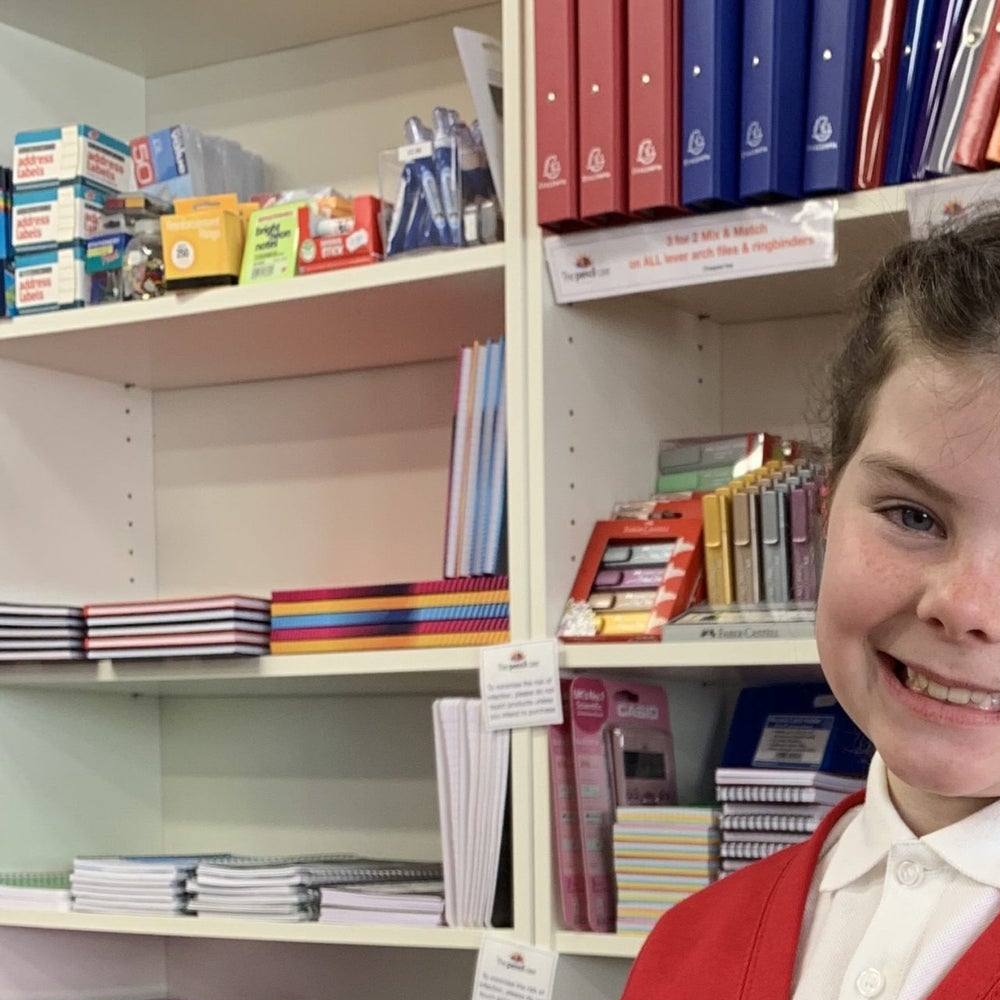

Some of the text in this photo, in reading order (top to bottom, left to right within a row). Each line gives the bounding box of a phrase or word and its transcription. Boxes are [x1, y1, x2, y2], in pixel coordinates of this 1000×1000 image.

[18, 154, 54, 166] address
[87, 152, 125, 174] address
[17, 165, 45, 178] labels
[87, 162, 116, 181] labels
[17, 215, 50, 228] address
[16, 226, 42, 240] labels
[255, 223, 281, 238] bright
[675, 233, 689, 245] for
[692, 232, 699, 243] 2
[701, 230, 719, 241] Mix
[723, 228, 730, 238] &
[733, 224, 768, 238] Match
[255, 240, 280, 251] notes
[629, 235, 815, 269] on ALL lever arch files & ringbinders
[19, 276, 52, 289] address
[19, 288, 44, 303] labels
